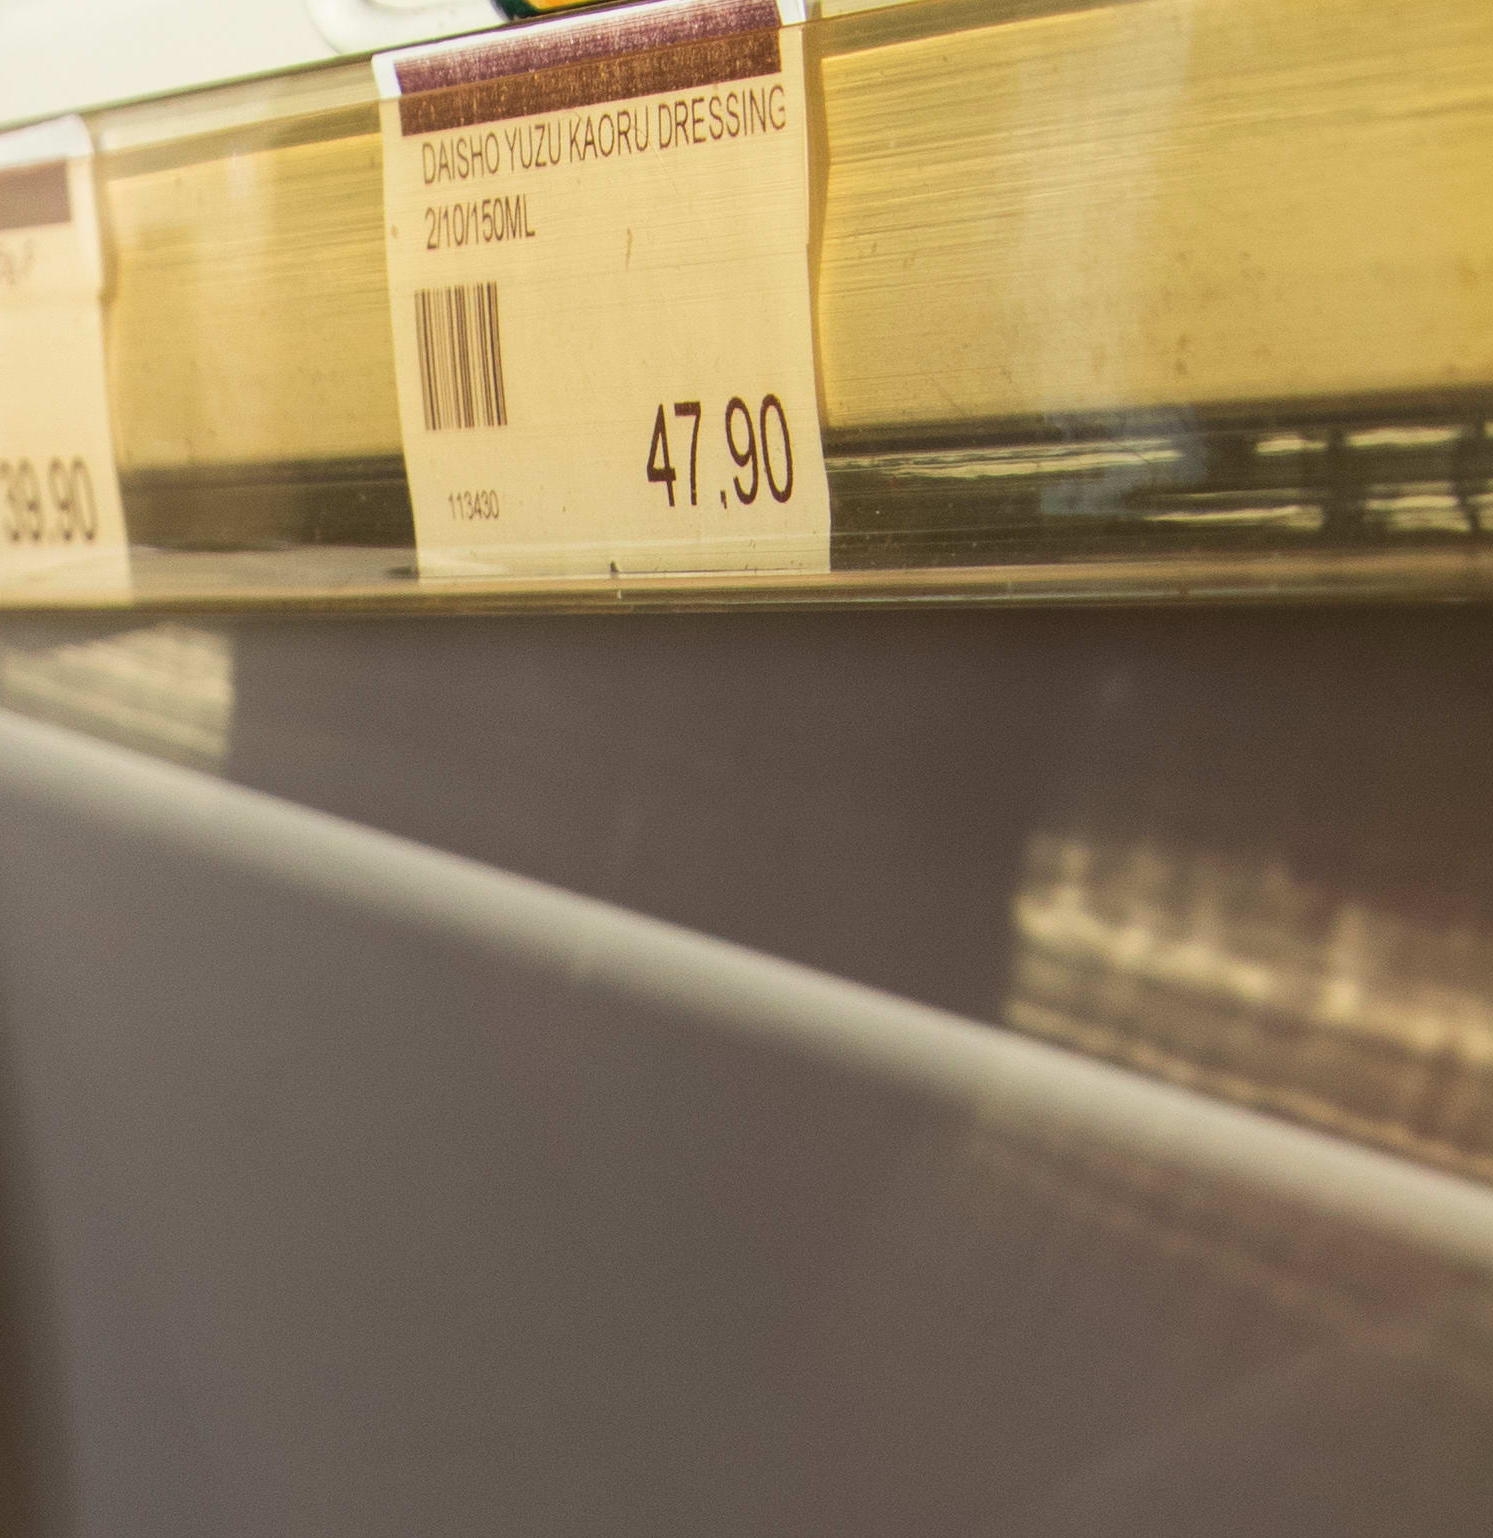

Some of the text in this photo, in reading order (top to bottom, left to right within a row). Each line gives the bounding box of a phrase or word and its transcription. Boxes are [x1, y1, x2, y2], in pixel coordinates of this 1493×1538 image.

[422, 84, 787, 185] DAISHO YUZU KAORU DRESSING
[425, 194, 536, 250] 2/10/150ML
[447, 489, 501, 522] 113430
